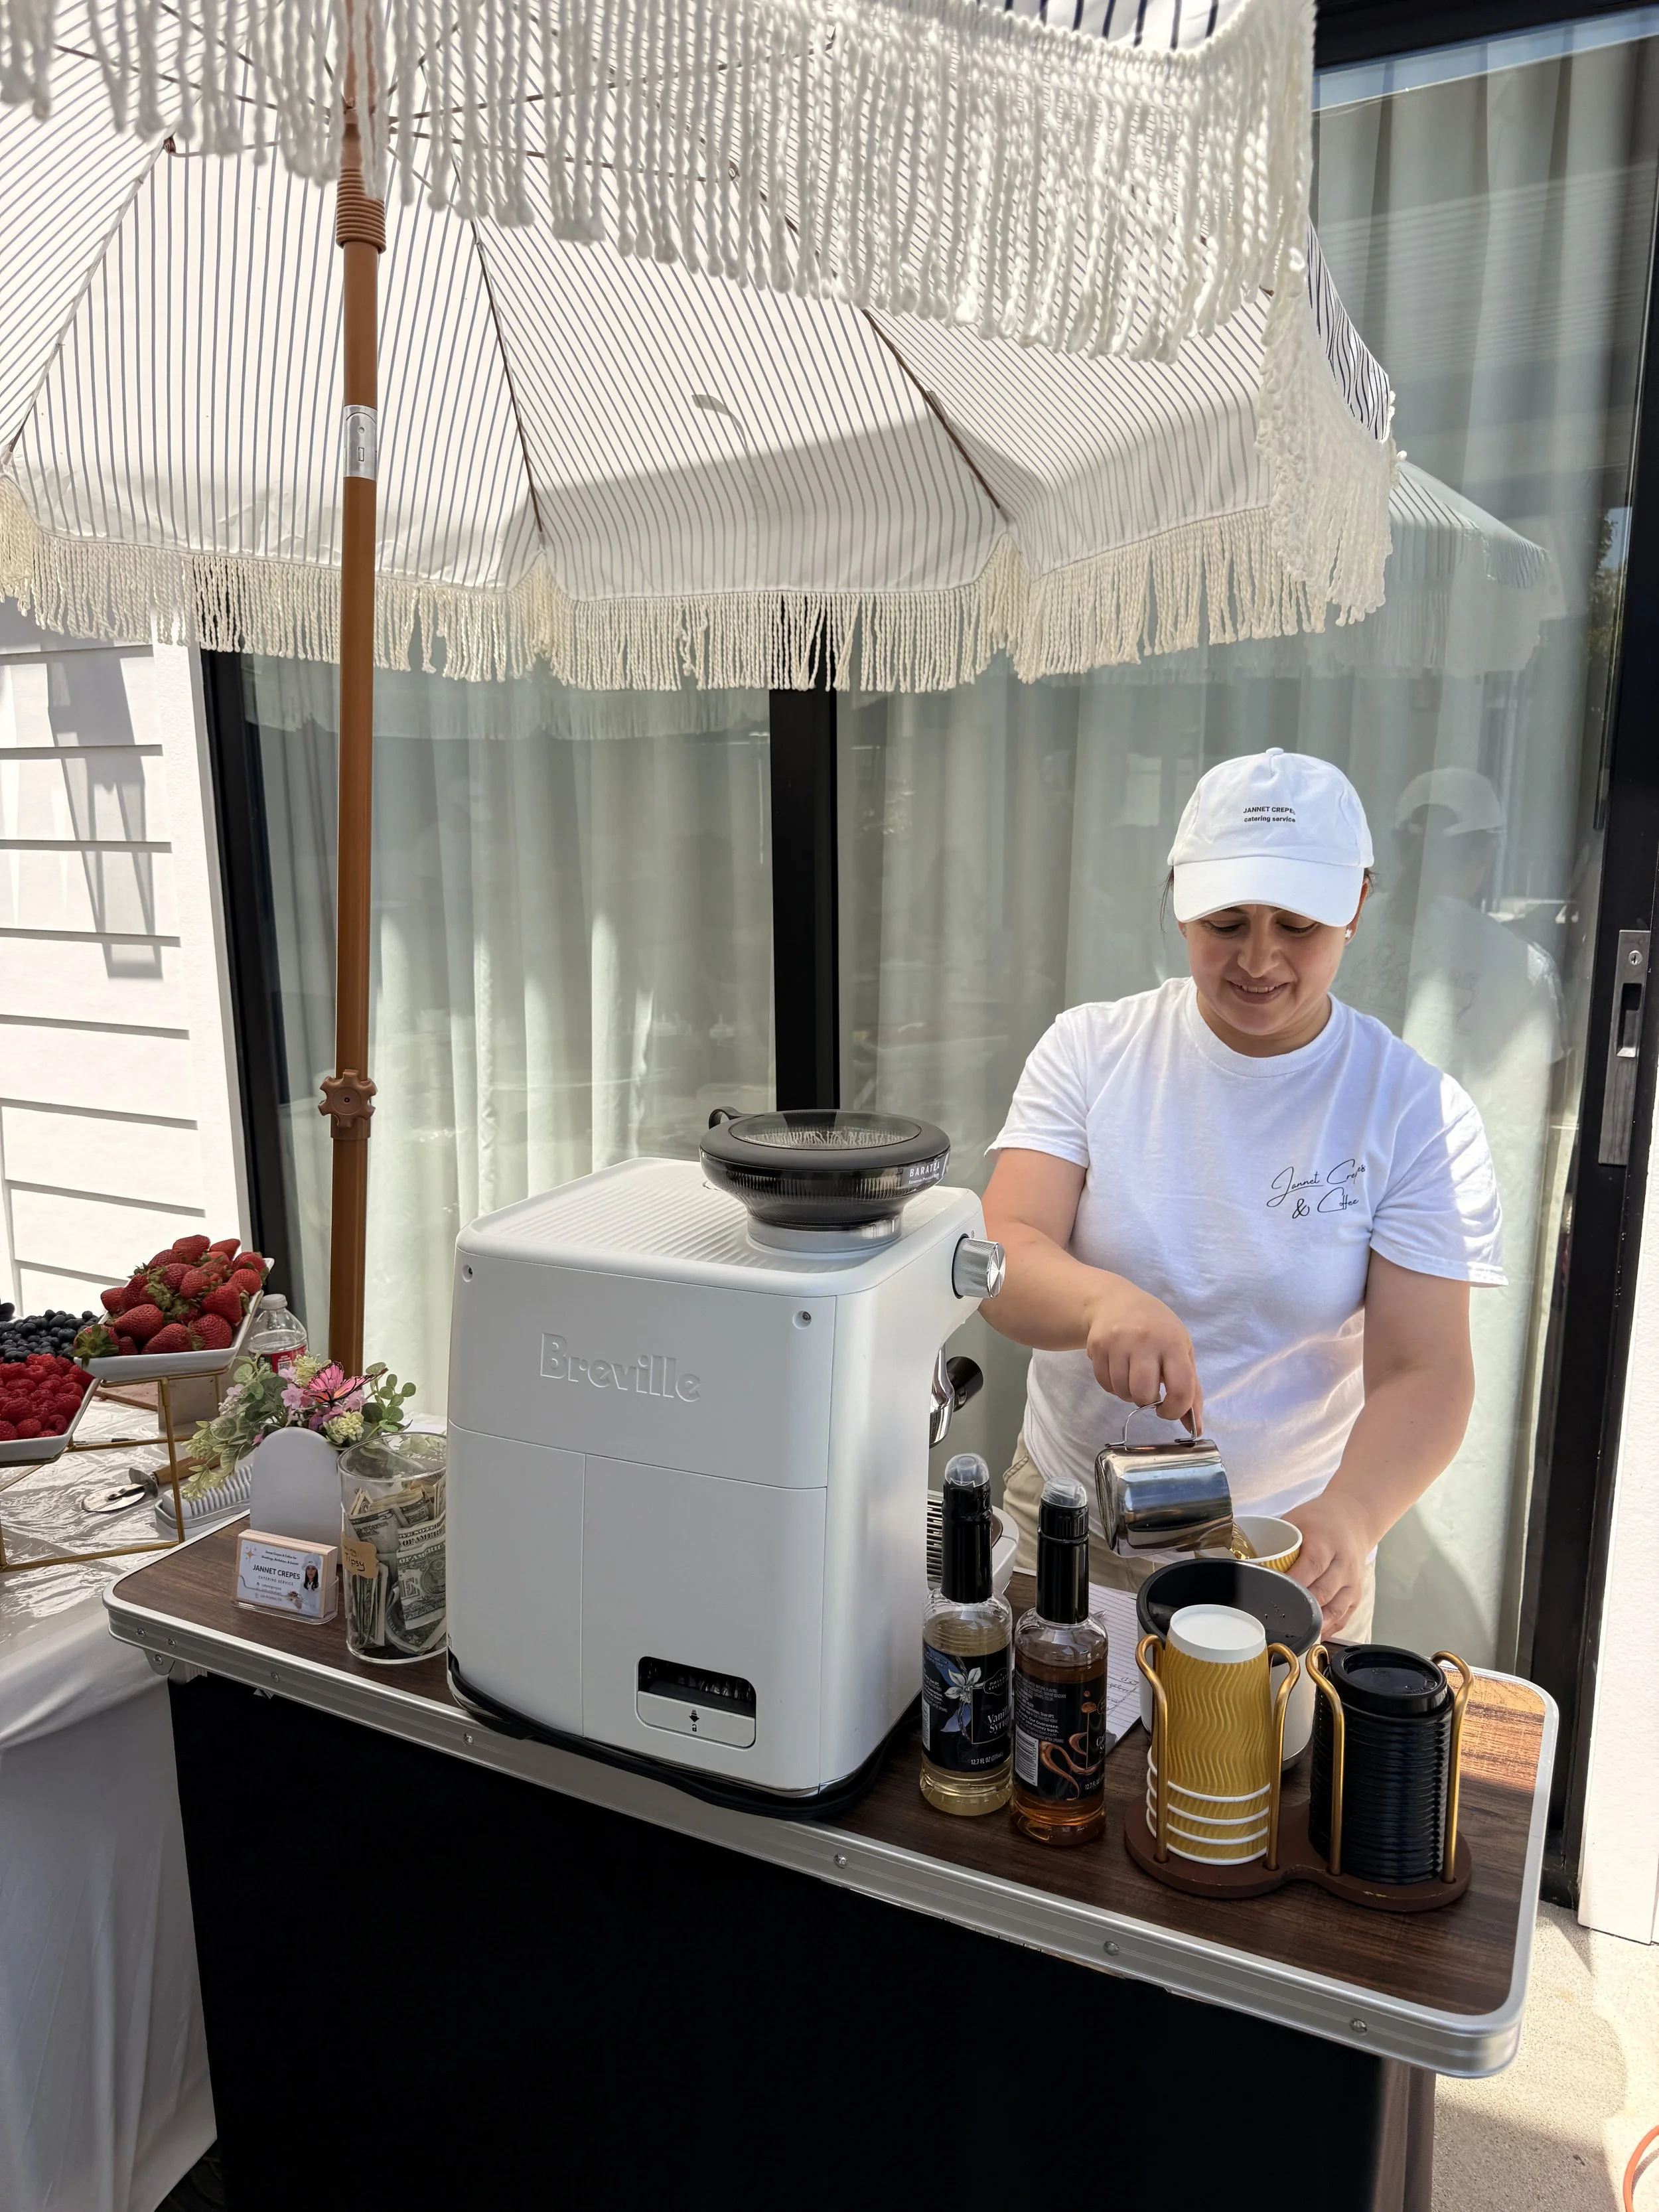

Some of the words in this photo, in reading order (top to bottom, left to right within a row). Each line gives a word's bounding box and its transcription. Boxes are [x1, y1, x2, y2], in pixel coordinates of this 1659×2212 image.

[910, 1161, 940, 1177] BARATZA
[1267, 1166, 1323, 1207] Jannet
[1292, 1199, 1310, 1219] &
[1317, 1187, 1359, 1213] Coffee
[540, 1333, 701, 1402] Breville
[253, 1564, 277, 1575] JANNET
[277, 1570, 301, 1580] CREPES
